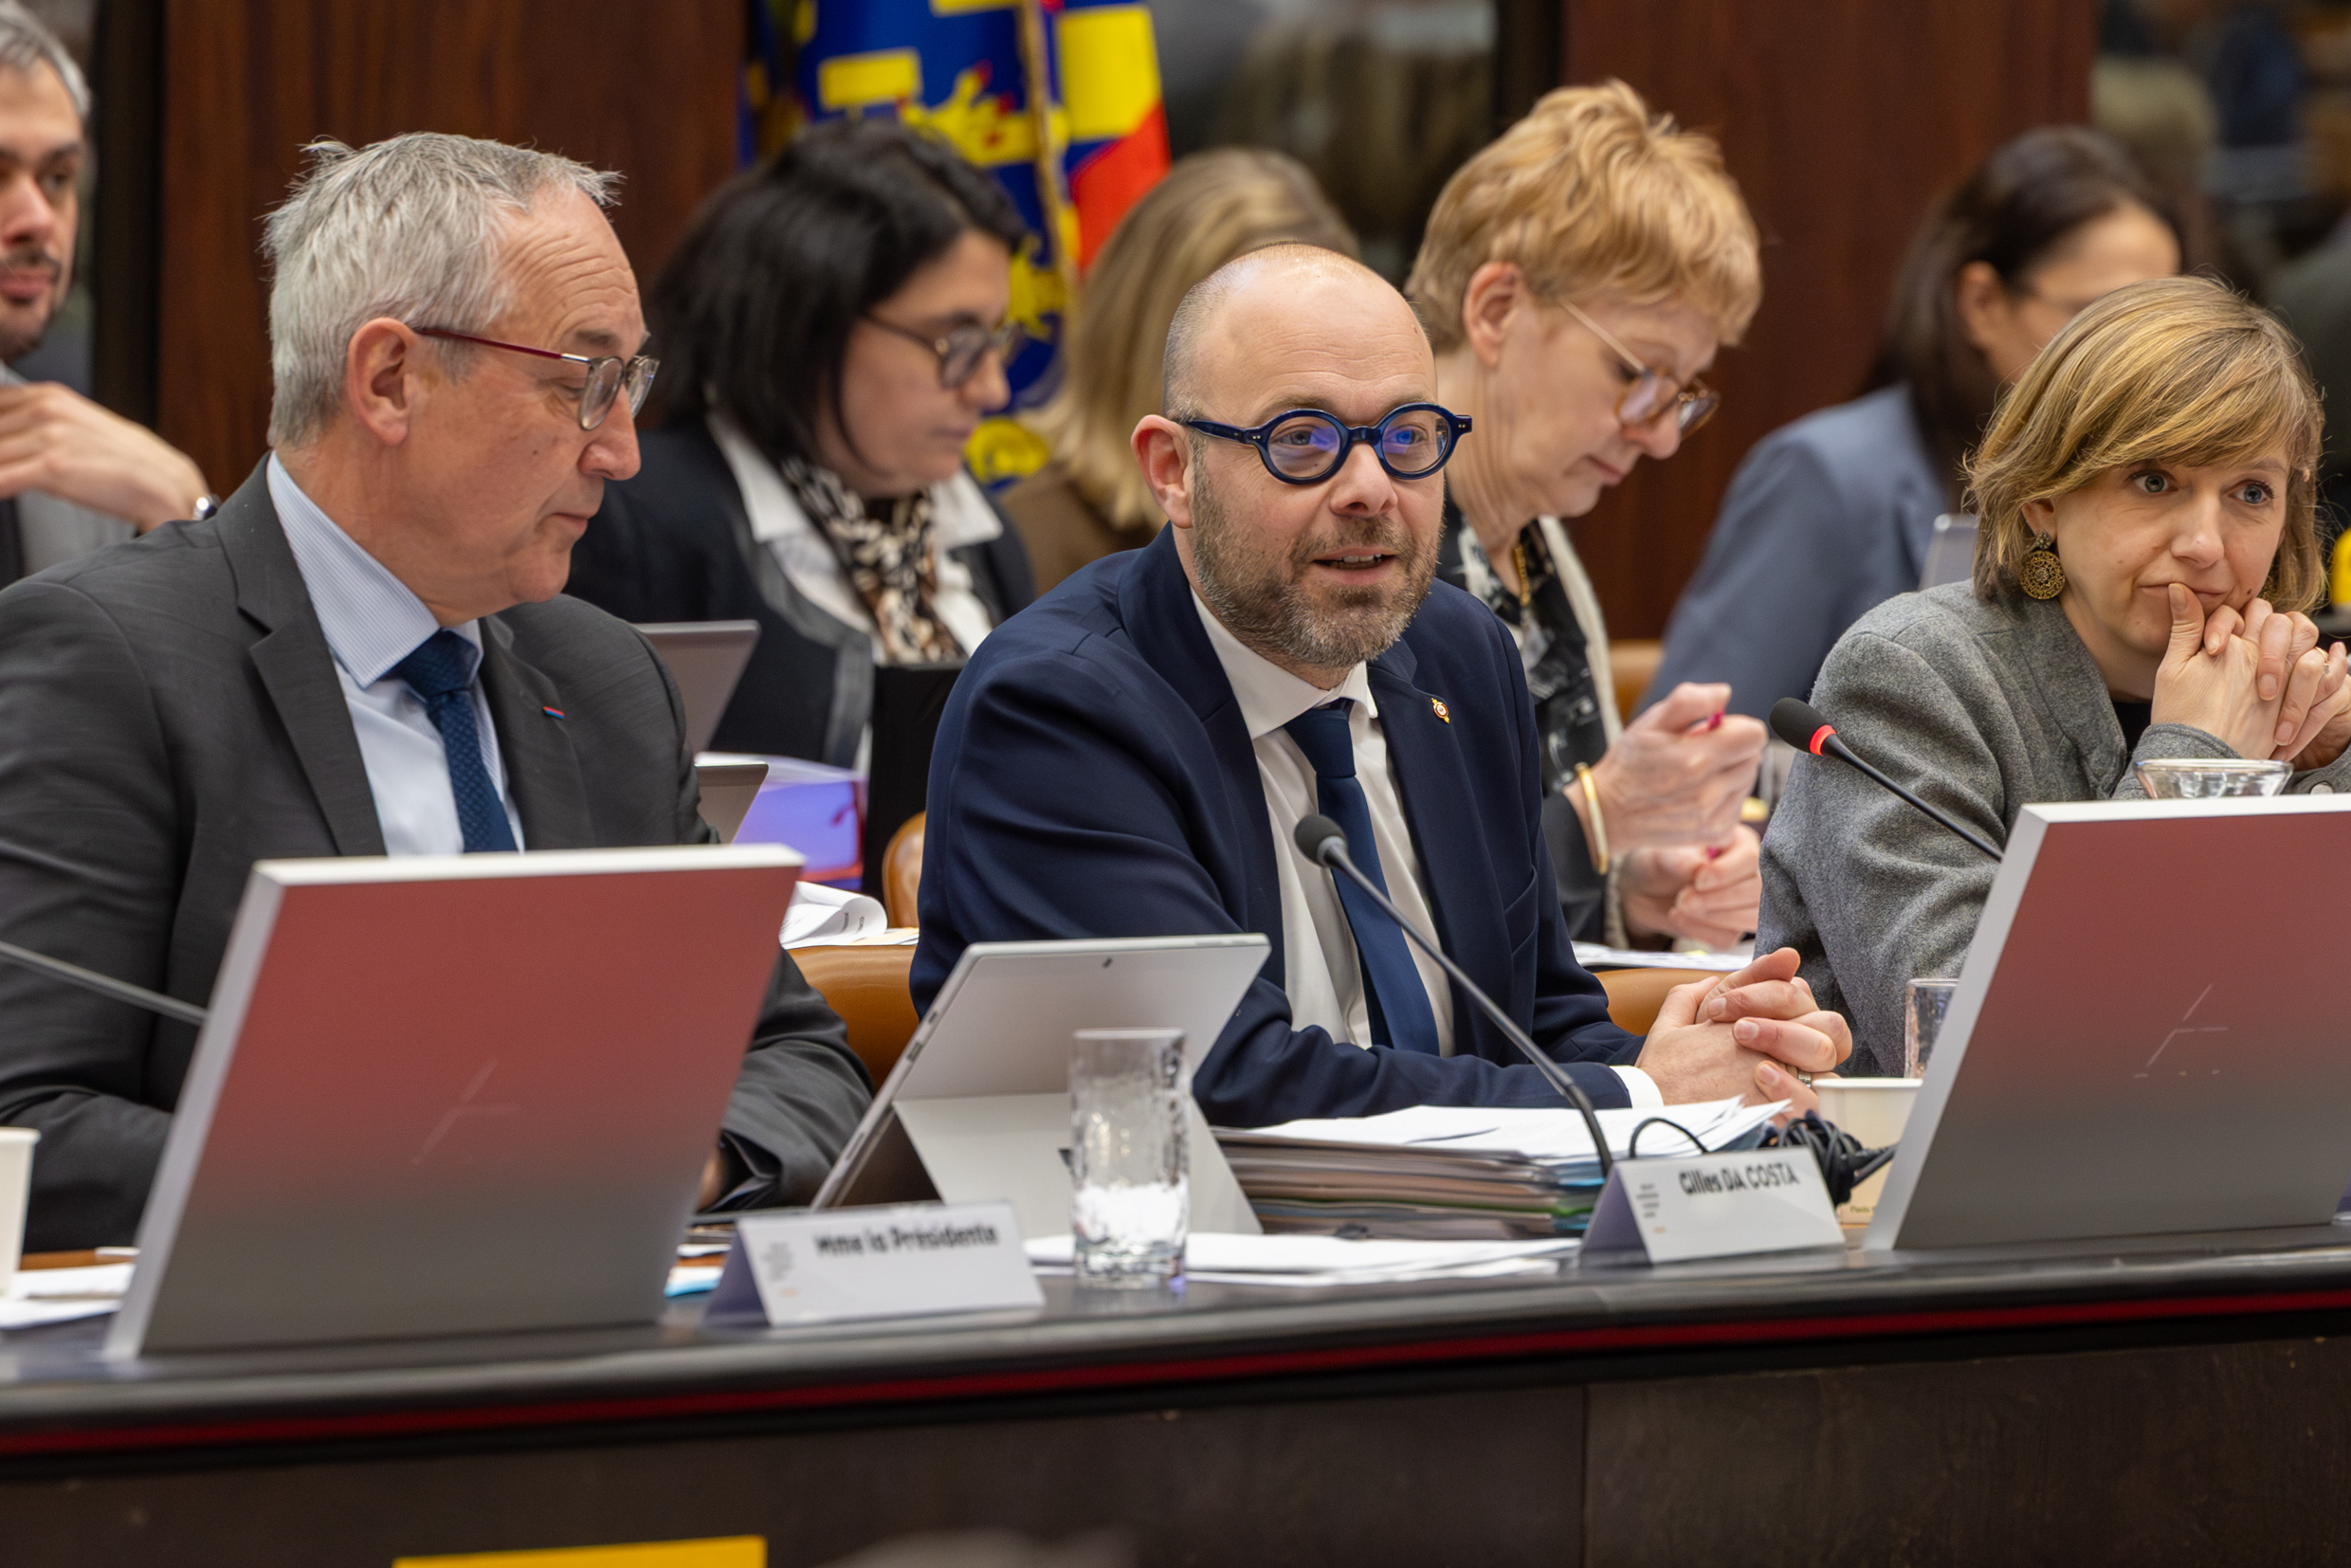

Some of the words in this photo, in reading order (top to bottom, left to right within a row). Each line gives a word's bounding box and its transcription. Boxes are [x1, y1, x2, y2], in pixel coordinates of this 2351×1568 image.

[1679, 1167, 1722, 1195] Gilles
[1721, 1166, 1746, 1192] DA
[1745, 1161, 1799, 1189] COSTA
